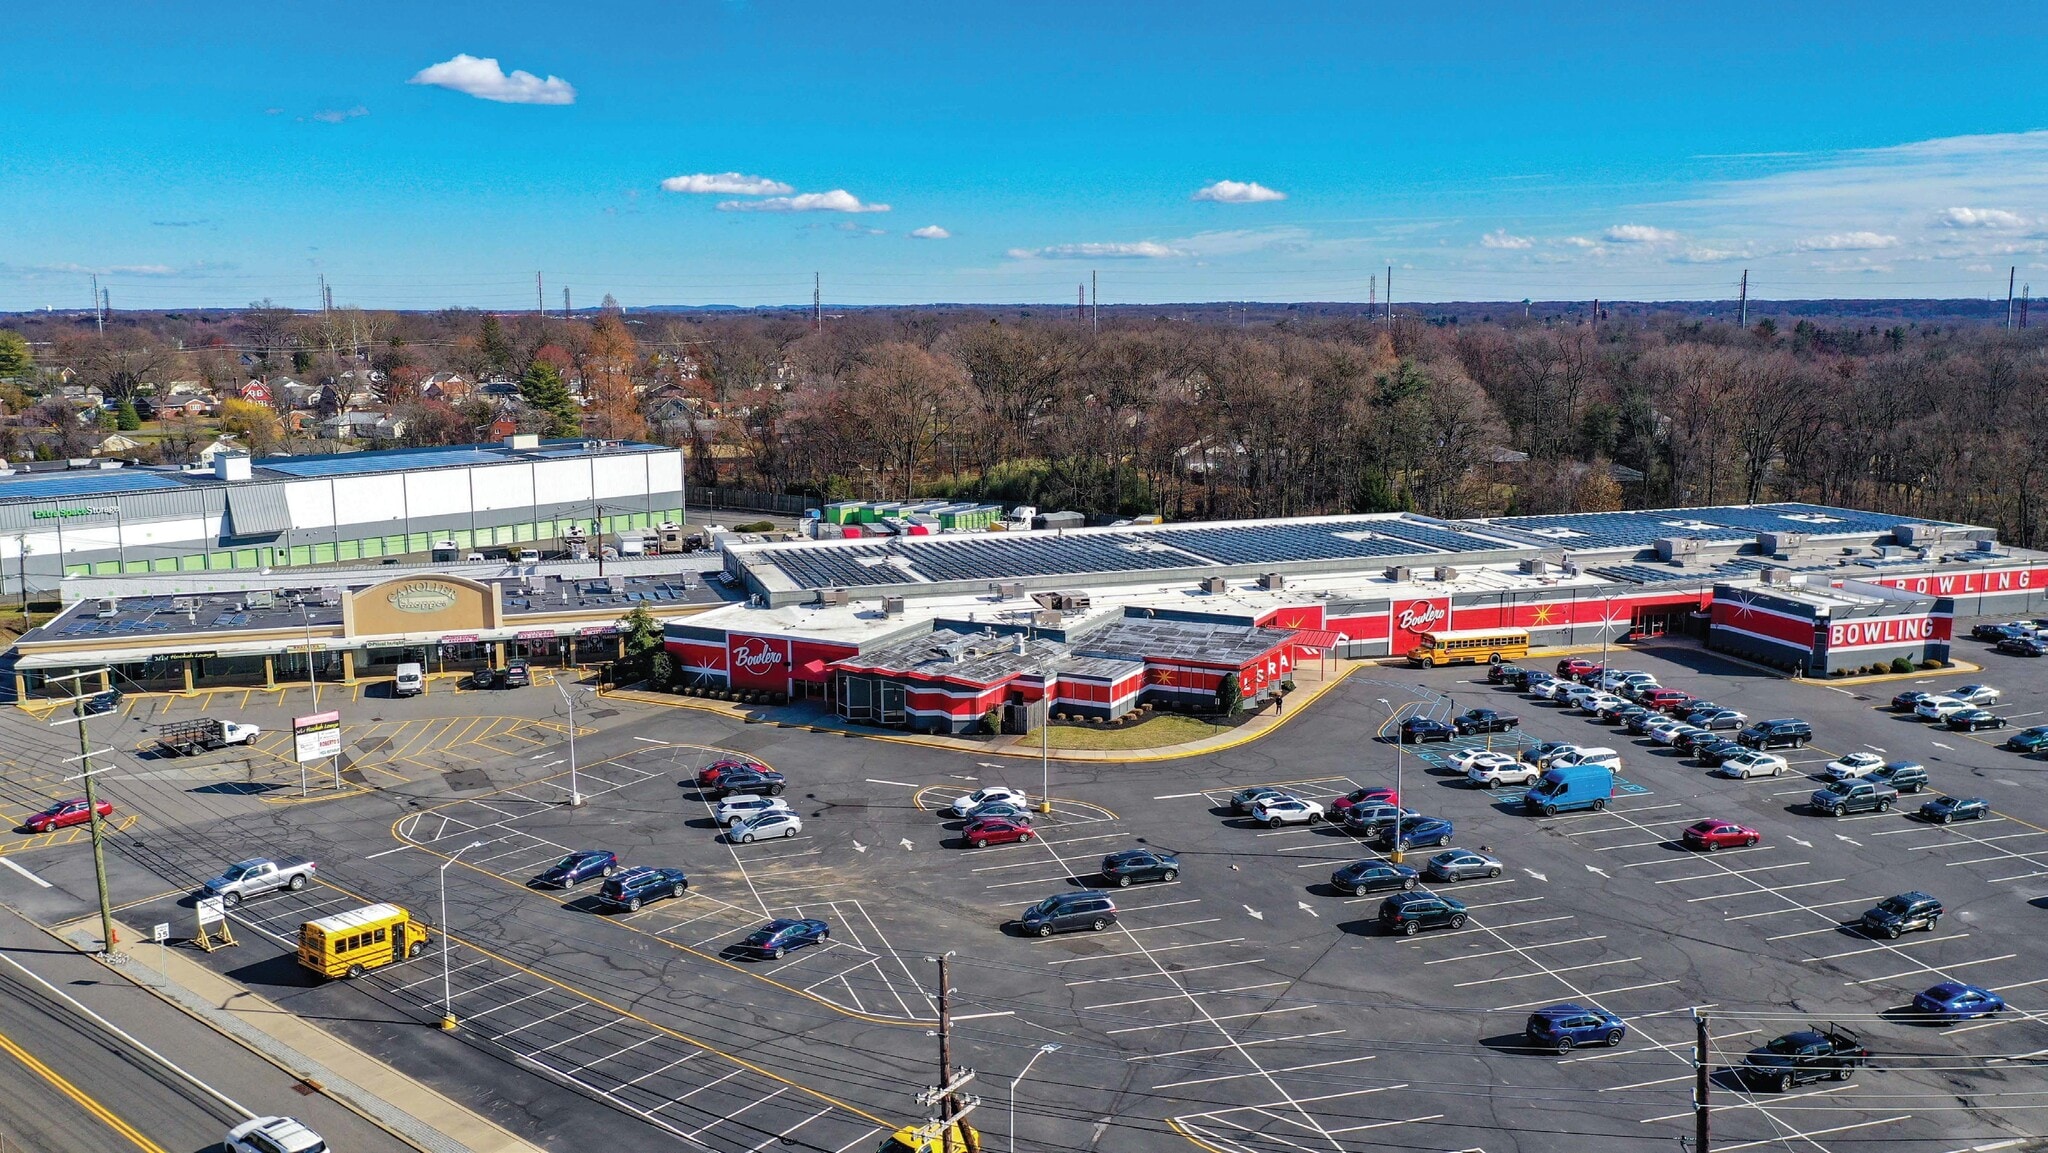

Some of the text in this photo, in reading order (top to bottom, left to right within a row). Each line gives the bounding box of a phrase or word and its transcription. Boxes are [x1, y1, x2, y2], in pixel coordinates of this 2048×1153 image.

[86, 505, 120, 515] Storage
[1895, 571, 2030, 594] BOWLING
[1399, 604, 1445, 629] Bowlero
[1831, 618, 1933, 645] BOWLING
[733, 644, 782, 666] Bowlero
